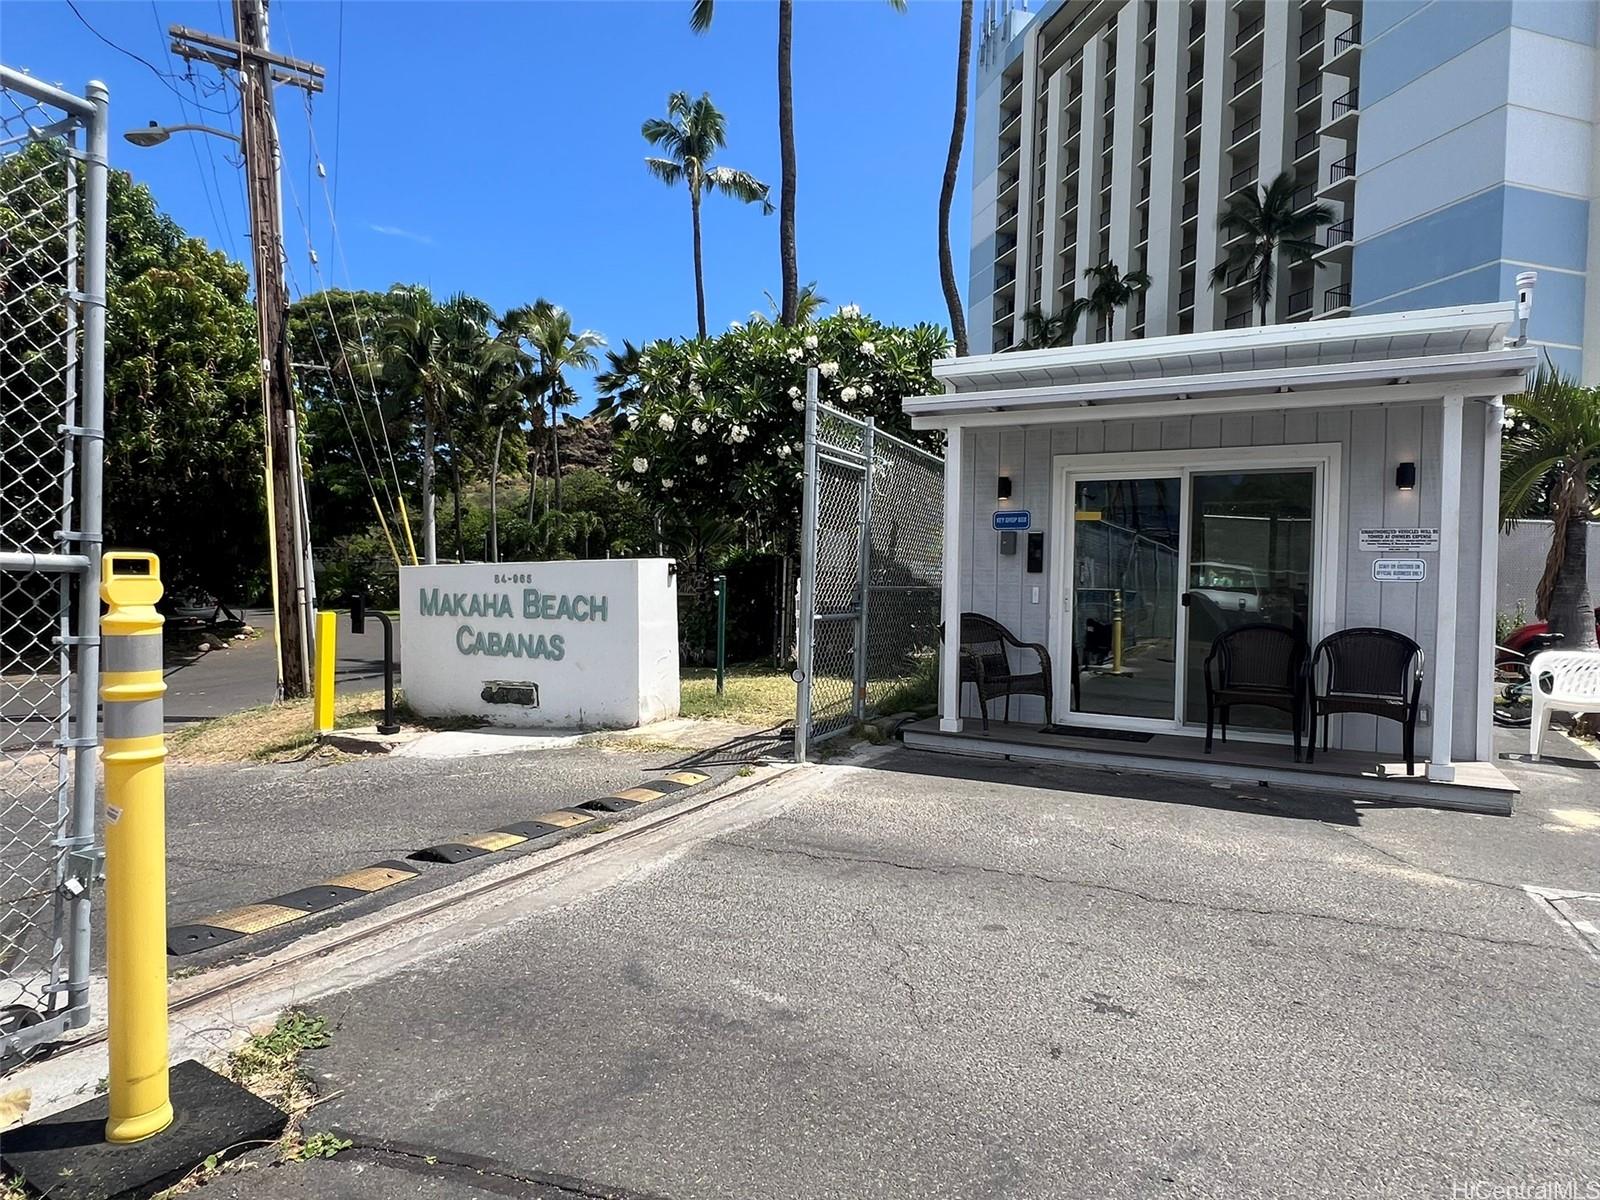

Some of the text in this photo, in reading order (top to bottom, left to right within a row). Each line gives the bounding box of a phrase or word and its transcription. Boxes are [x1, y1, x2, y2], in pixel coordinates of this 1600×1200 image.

[419, 588, 609, 622] MAKAHA BEACH
[456, 624, 566, 662] CABANAS
